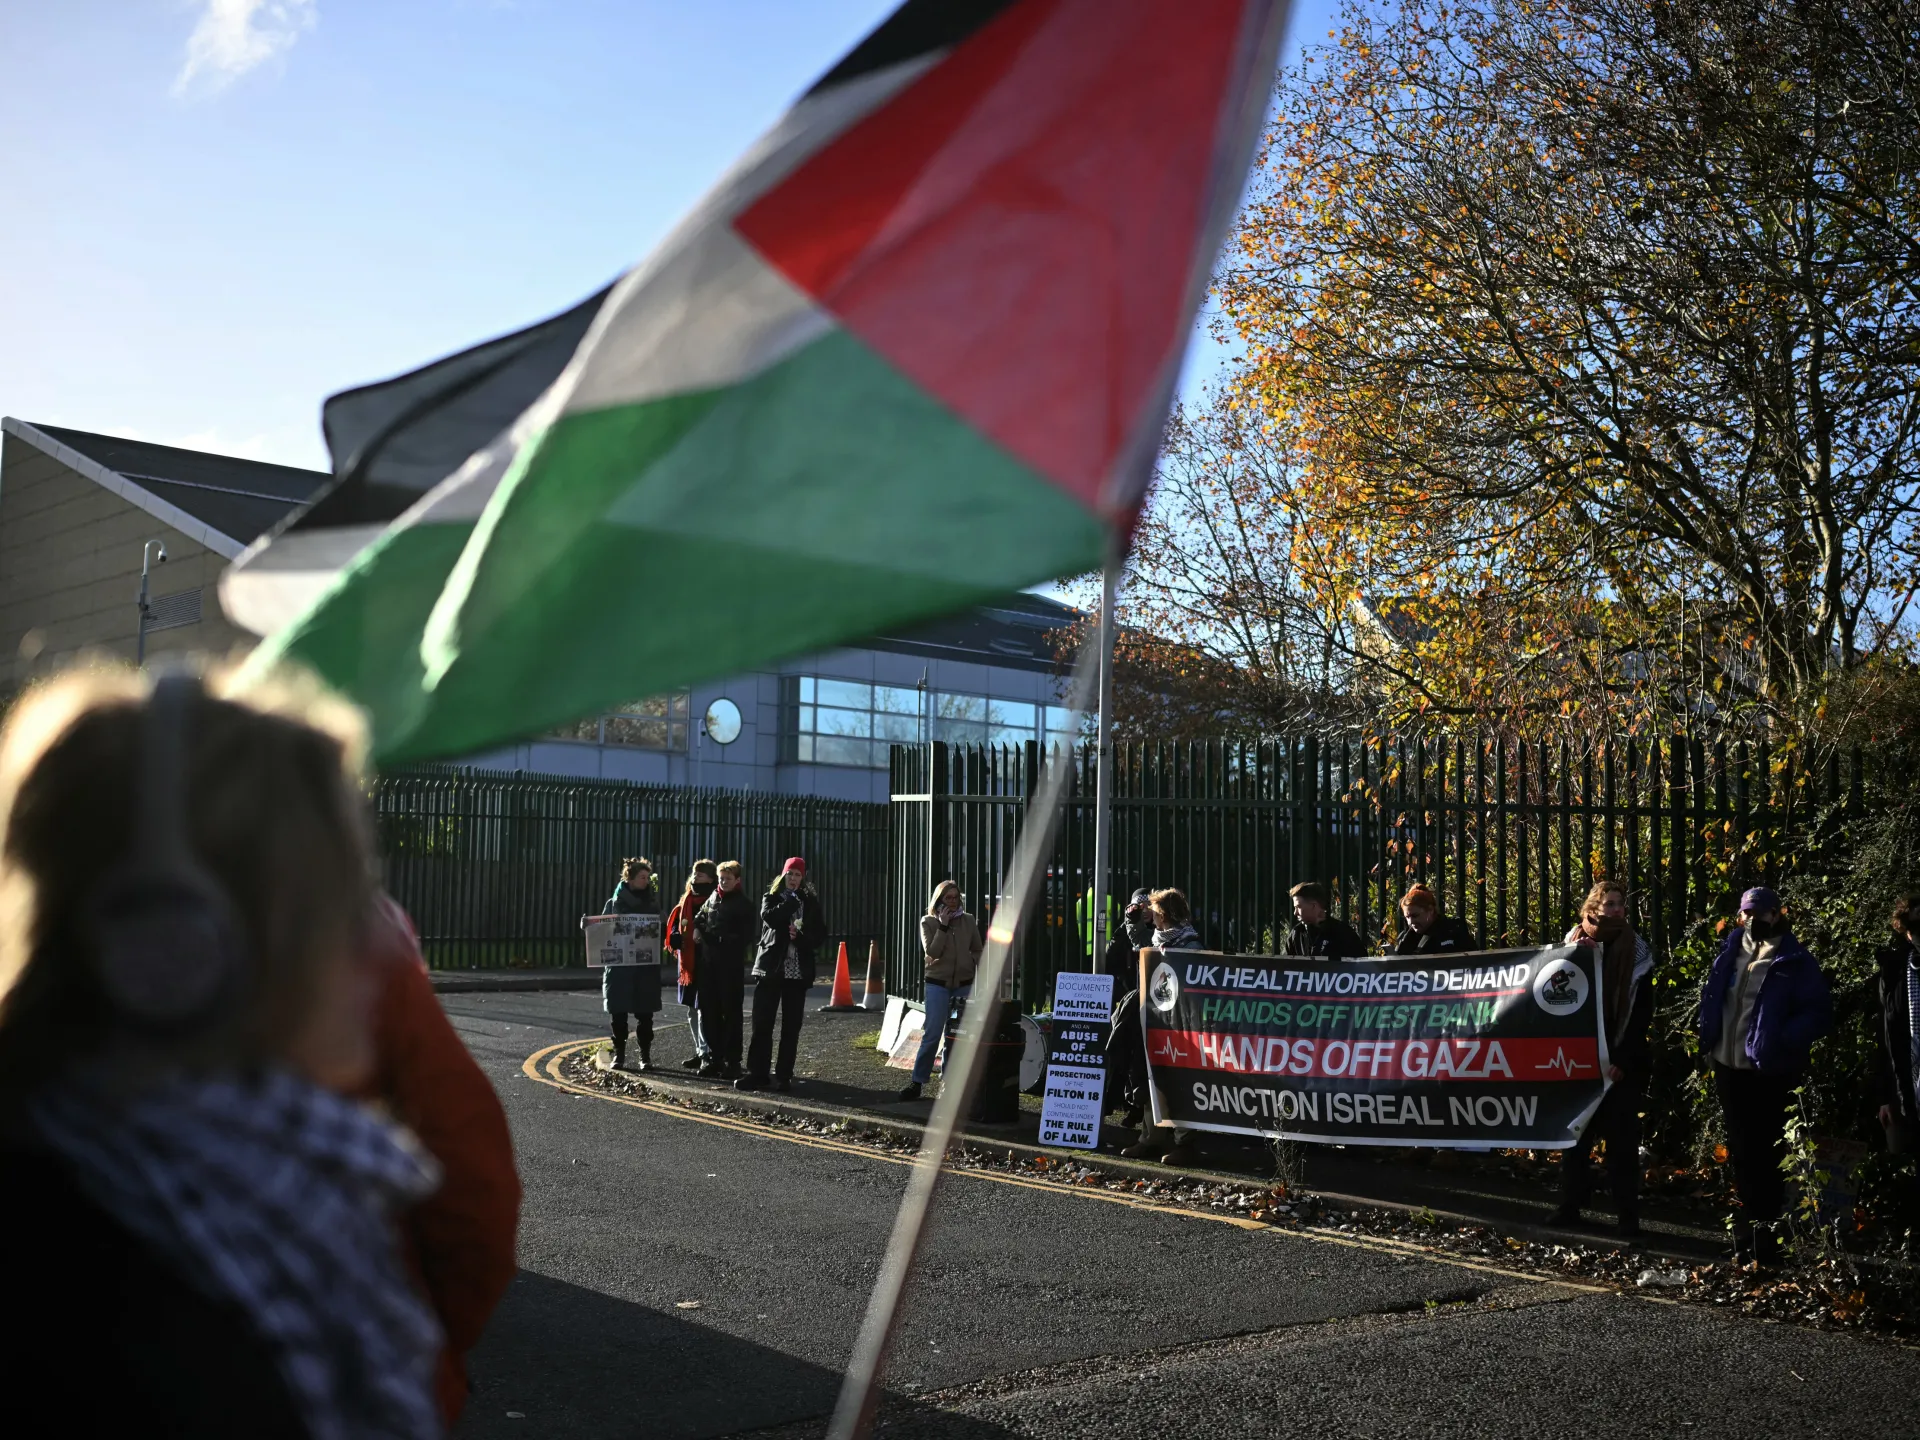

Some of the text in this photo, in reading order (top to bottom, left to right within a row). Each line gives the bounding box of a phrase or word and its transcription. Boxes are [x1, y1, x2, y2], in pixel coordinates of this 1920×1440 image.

[1185, 964, 1530, 994] UK HEALTHWORKERS DEMAND
[1058, 982, 1111, 992] DOCUMENTS
[1057, 999, 1108, 1010] POLITICAL
[1055, 1010, 1108, 1019] INTERFERENCE
[1202, 998, 1501, 1029] HANDS OFF WEST BANK
[1060, 1030, 1099, 1042] ABUSE
[1070, 1042, 1086, 1052] OF
[1051, 1052, 1104, 1064] PROCESS
[1199, 1034, 1514, 1078] HANDS OFF GAZA
[1049, 1070, 1101, 1080] PROSECTIONS
[1046, 1088, 1100, 1101] FILTON 18
[1053, 1102, 1076, 1110] SHOULD
[1193, 1081, 1539, 1127] SANCTION ISREAL NOW
[1046, 1111, 1075, 1119] CONTINUE
[1045, 1119, 1093, 1131] THE RULE
[1043, 1131, 1091, 1144] OF LAW.
